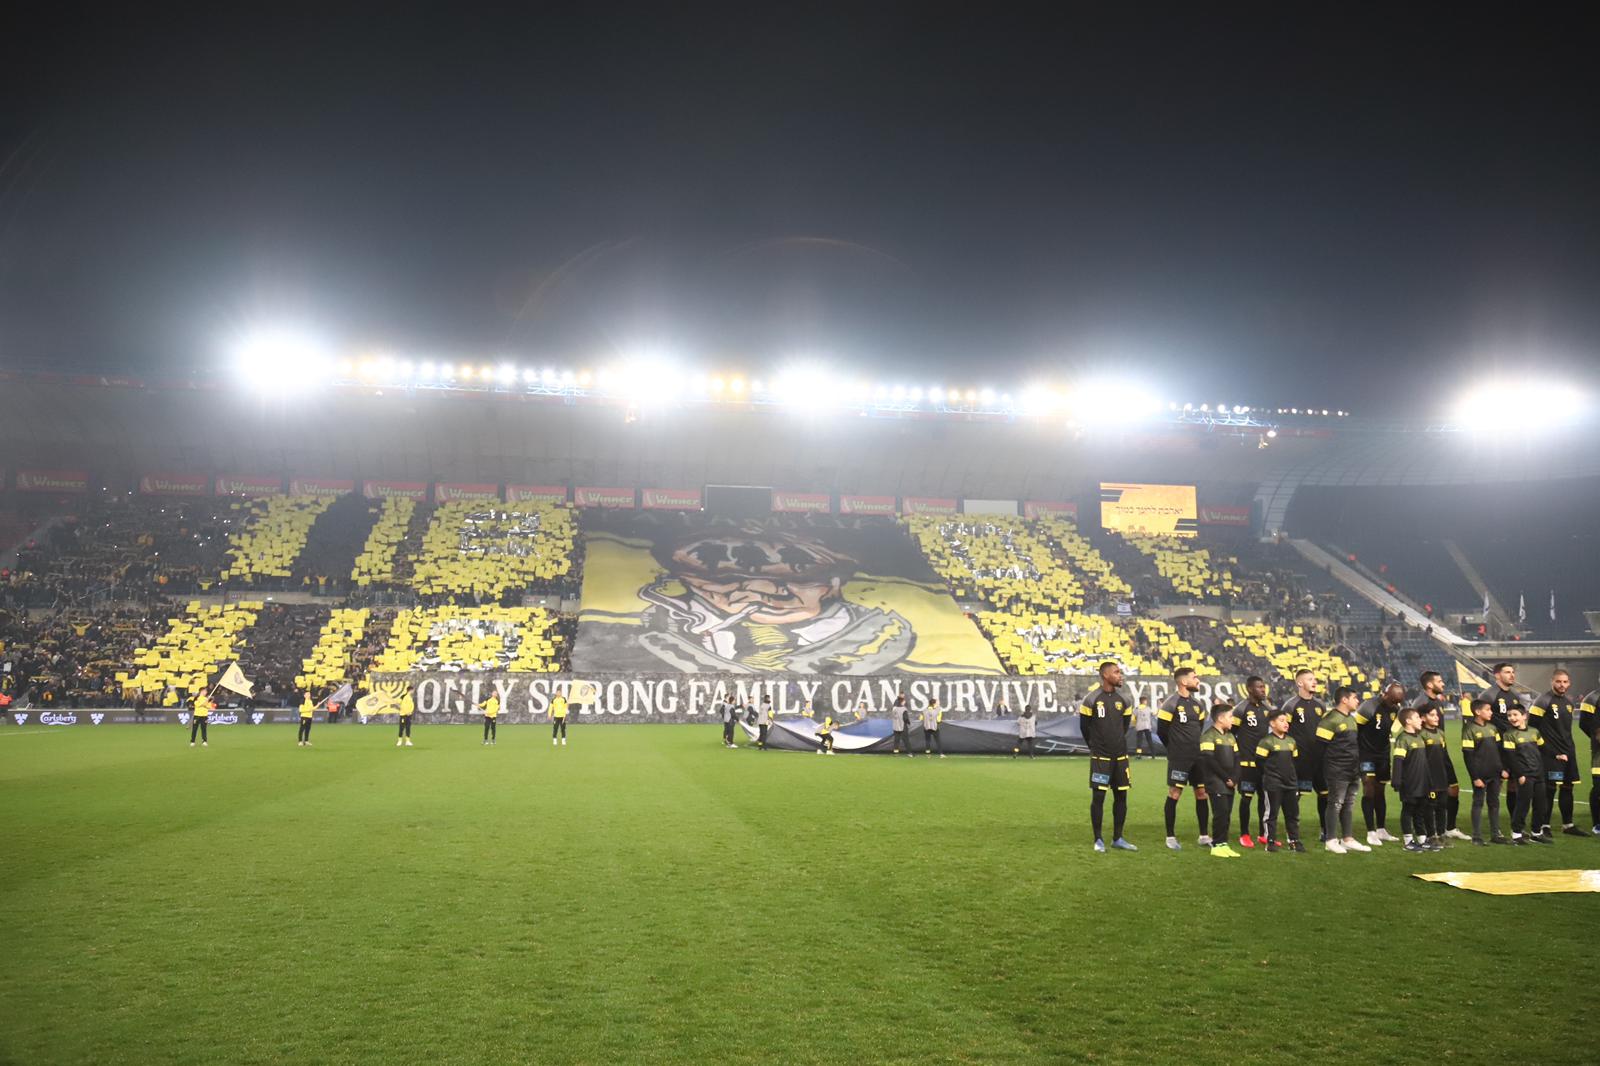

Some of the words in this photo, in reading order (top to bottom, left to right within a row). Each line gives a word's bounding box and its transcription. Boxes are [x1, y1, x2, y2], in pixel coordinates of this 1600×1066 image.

[377, 486, 425, 497] Winner
[587, 492, 633, 504] Winner
[656, 494, 699, 506] Winner
[785, 497, 827, 509] Winner
[852, 499, 894, 511] Winner
[1210, 510, 1248, 522] Winner
[416, 678, 518, 715] ONLY
[528, 678, 678, 715] STRONG
[687, 678, 822, 715] FAMILY
[831, 679, 902, 714] CAN
[1126, 680, 1233, 714] YERS
[1096, 705, 1106, 718] 10
[1178, 711, 1188, 723] 16
[1298, 711, 1305, 723] 3
[1553, 707, 1559, 719] 5
[40, 711, 77, 725] Carlsberg
[1246, 714, 1258, 727] 55
[1375, 719, 1381, 730] 2
